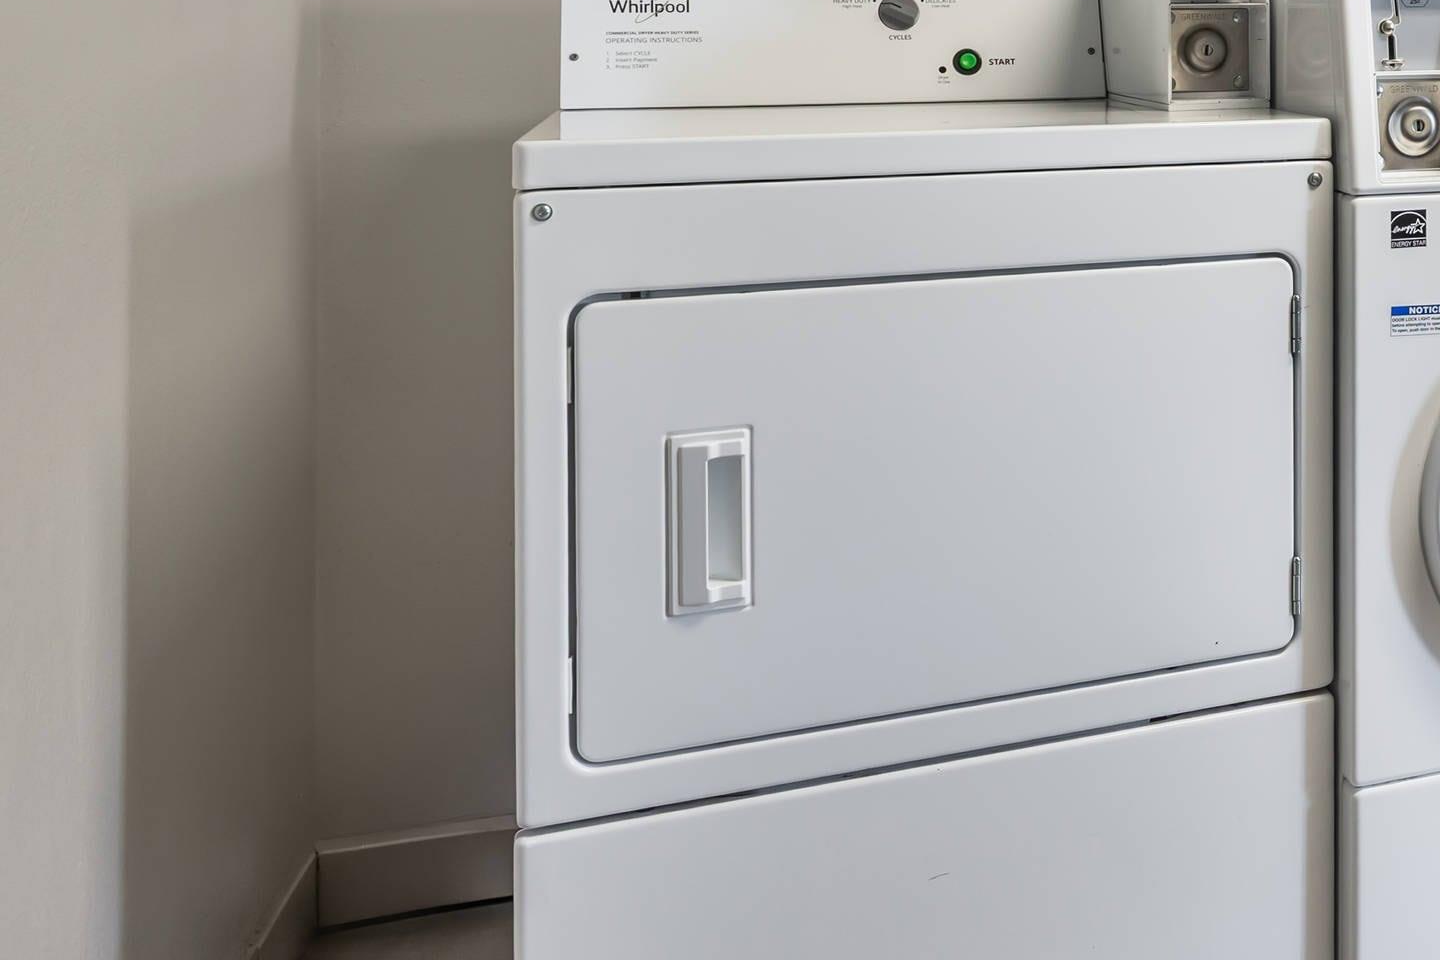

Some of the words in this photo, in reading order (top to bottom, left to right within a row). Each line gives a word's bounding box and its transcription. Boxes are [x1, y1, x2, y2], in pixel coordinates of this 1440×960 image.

[609, 0, 690, 17] Whirlpool
[1391, 240, 1412, 248] ENERGY
[1413, 239, 1426, 247] STAR
